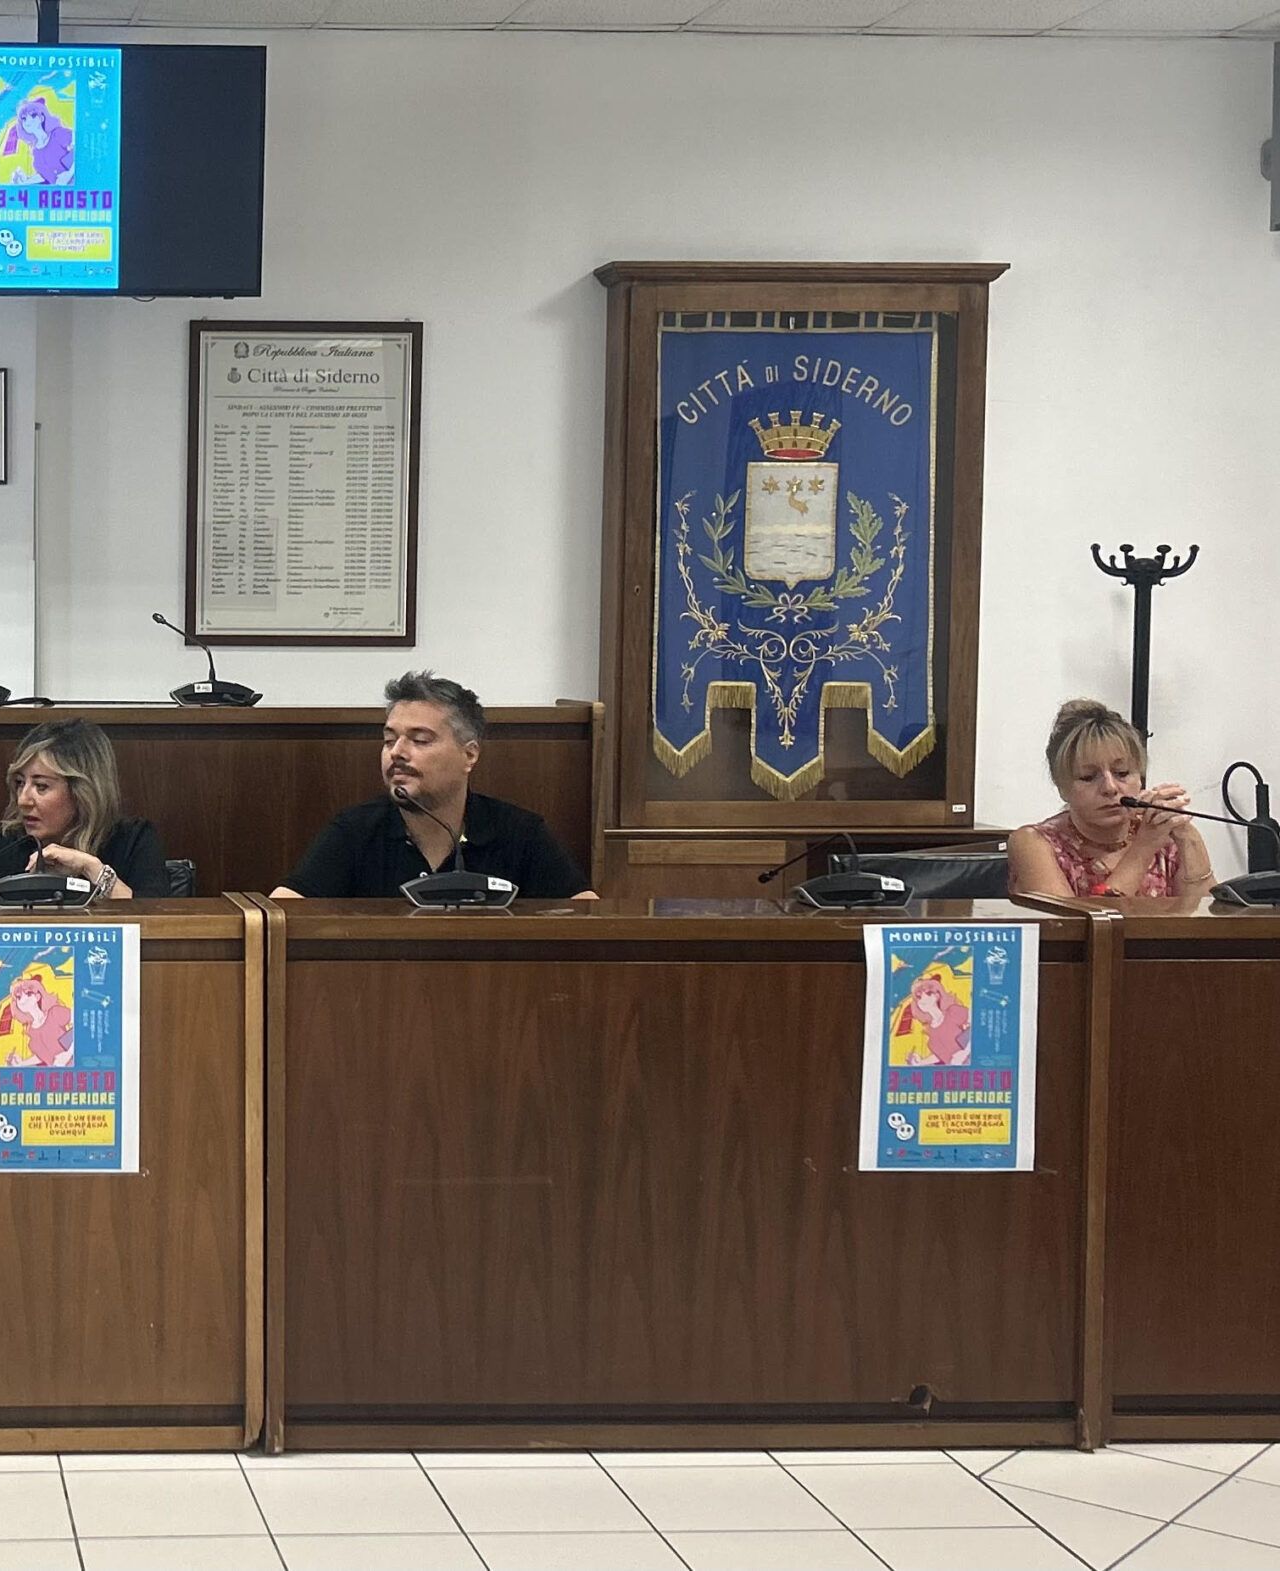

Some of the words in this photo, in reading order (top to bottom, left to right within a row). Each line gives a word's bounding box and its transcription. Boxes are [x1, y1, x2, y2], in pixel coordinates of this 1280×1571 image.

[39, 190, 113, 209] AGOSTO
[253, 343, 318, 360] Repubblica
[321, 344, 375, 357] Italiana
[247, 368, 288, 383] Città
[293, 368, 309, 383] di
[315, 369, 380, 384] Siderno
[793, 355, 913, 427] SIDERNO
[34, 1071, 116, 1092] AGOSTO
[932, 1070, 1013, 1090] AGOSTO
[46, 1092, 116, 1106] SUPERIORE
[886, 1091, 939, 1104] SIDERNO
[943, 1091, 1013, 1104] SUPERIORE
